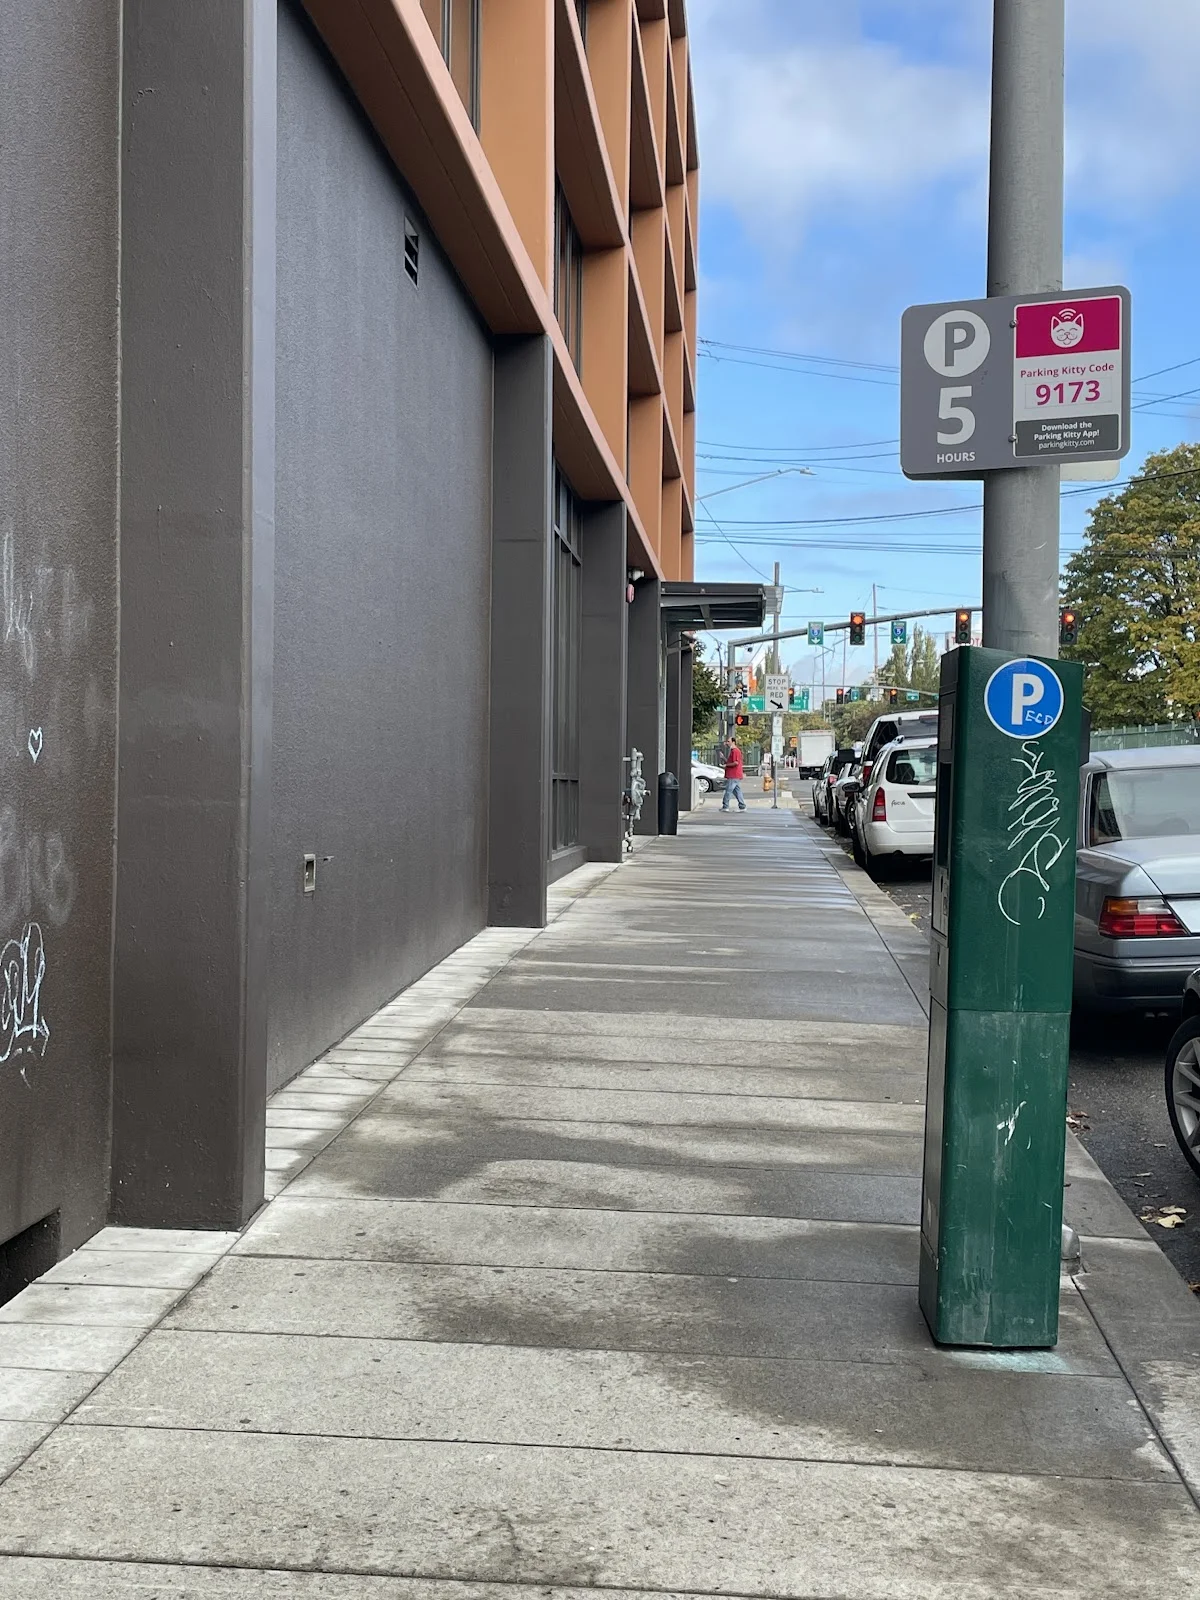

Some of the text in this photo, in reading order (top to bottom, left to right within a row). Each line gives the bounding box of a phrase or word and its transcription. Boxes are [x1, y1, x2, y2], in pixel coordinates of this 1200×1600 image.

[944, 321, 976, 367] P
[1020, 362, 1115, 379] Parking Kitty Code
[1035, 380, 1101, 406] 9173
[936, 385, 976, 446] 5
[1033, 429, 1100, 441] Parking Kitty App!
[1041, 421, 1093, 432] Download the
[1038, 439, 1095, 451] parkingkitty.com
[936, 451, 976, 463] HOURS
[1011, 673, 1045, 726] P
